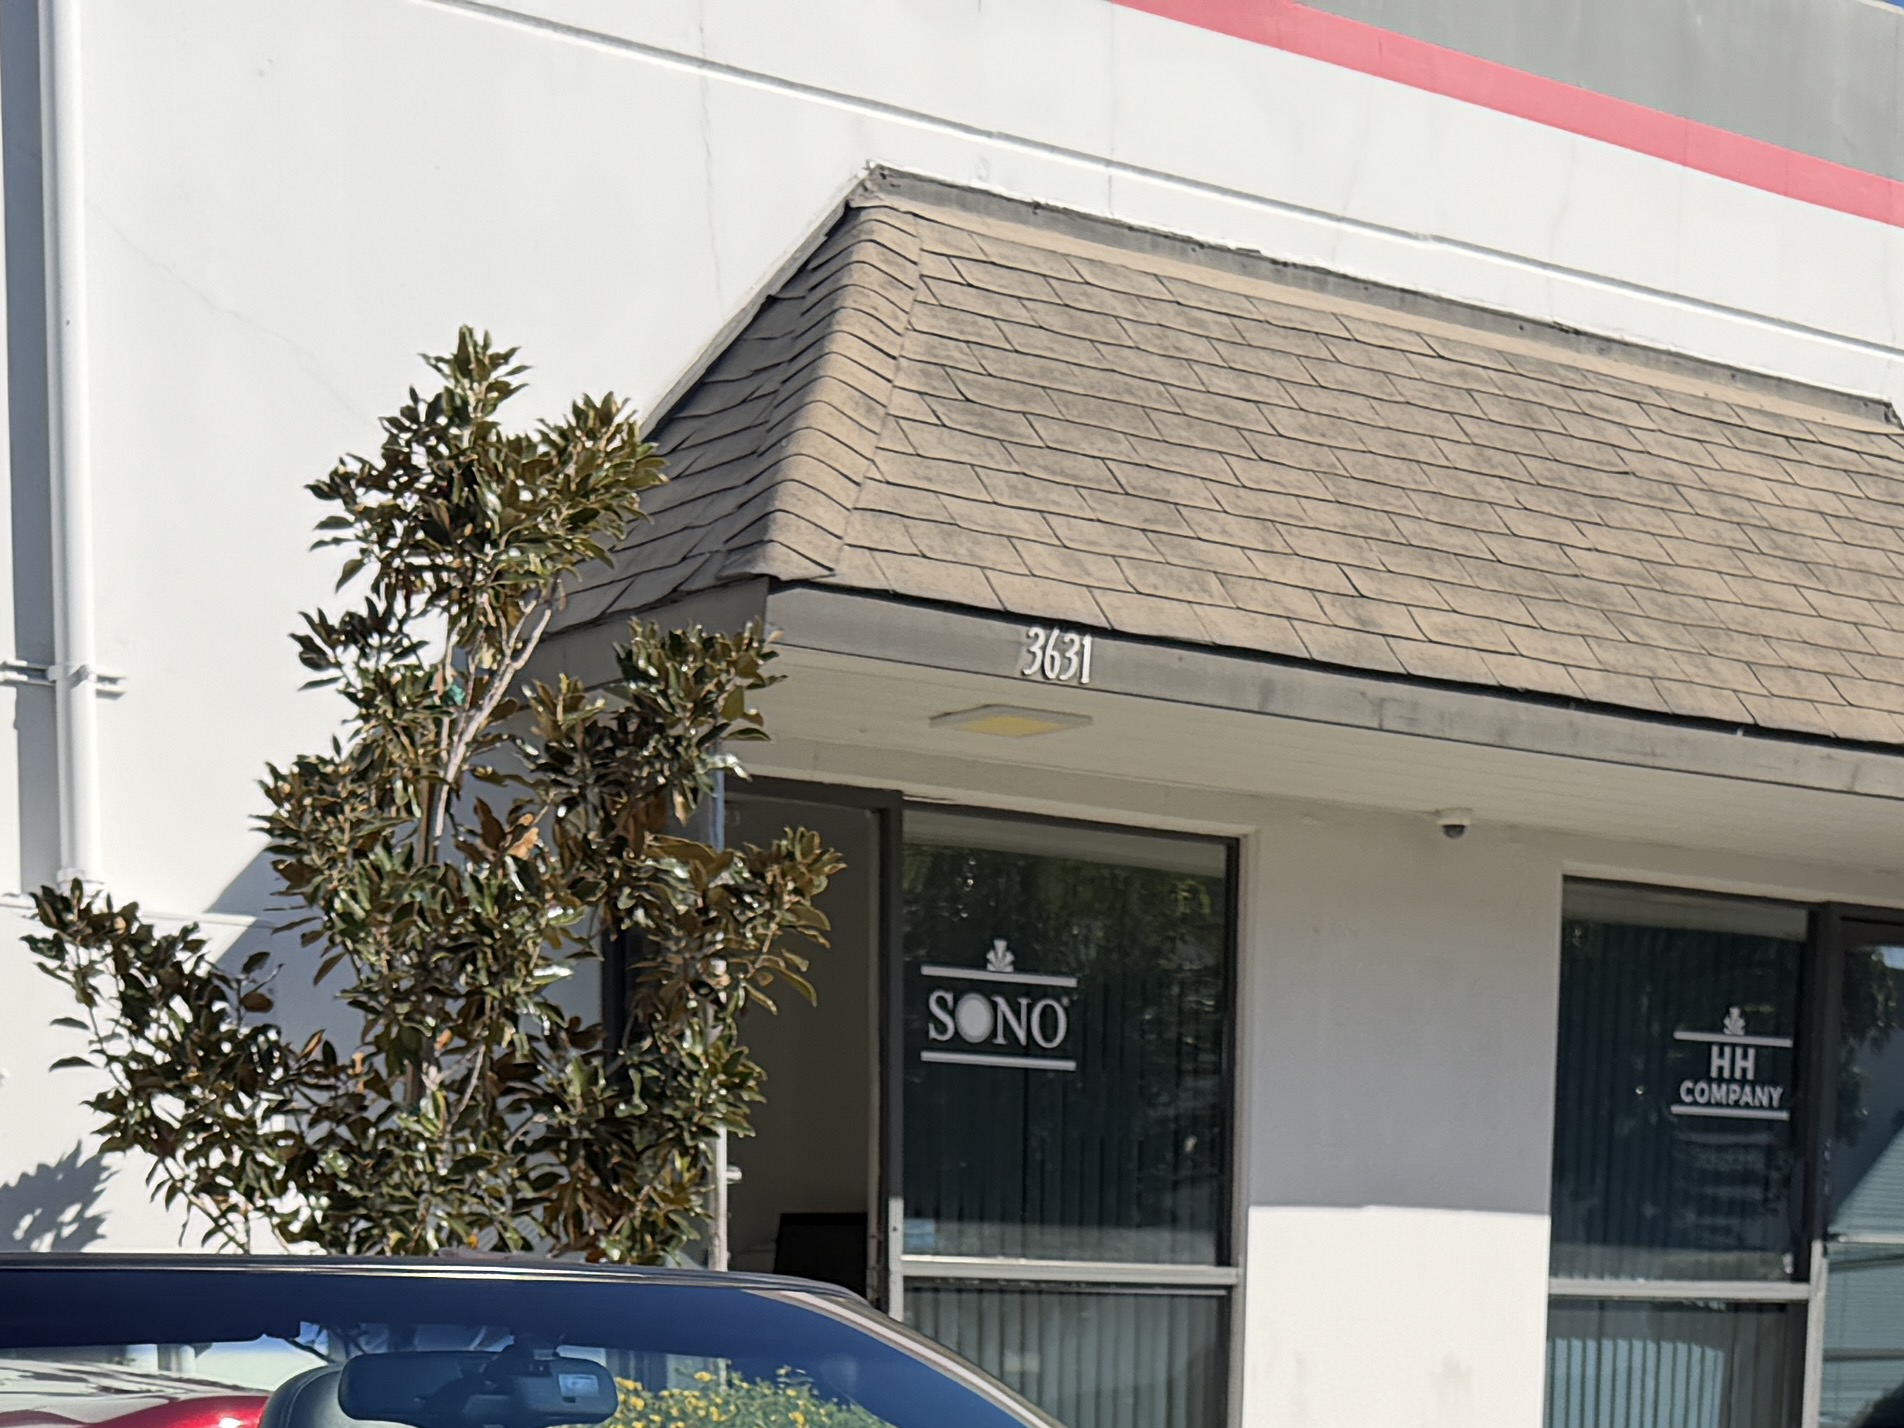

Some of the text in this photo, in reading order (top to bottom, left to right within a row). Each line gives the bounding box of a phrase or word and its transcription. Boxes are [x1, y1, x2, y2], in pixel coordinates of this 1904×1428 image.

[1022, 626, 1093, 684] 3631
[928, 989, 1068, 1049] SONO
[1710, 1044, 1756, 1080] HH
[1679, 1079, 1784, 1108] COMPANY
